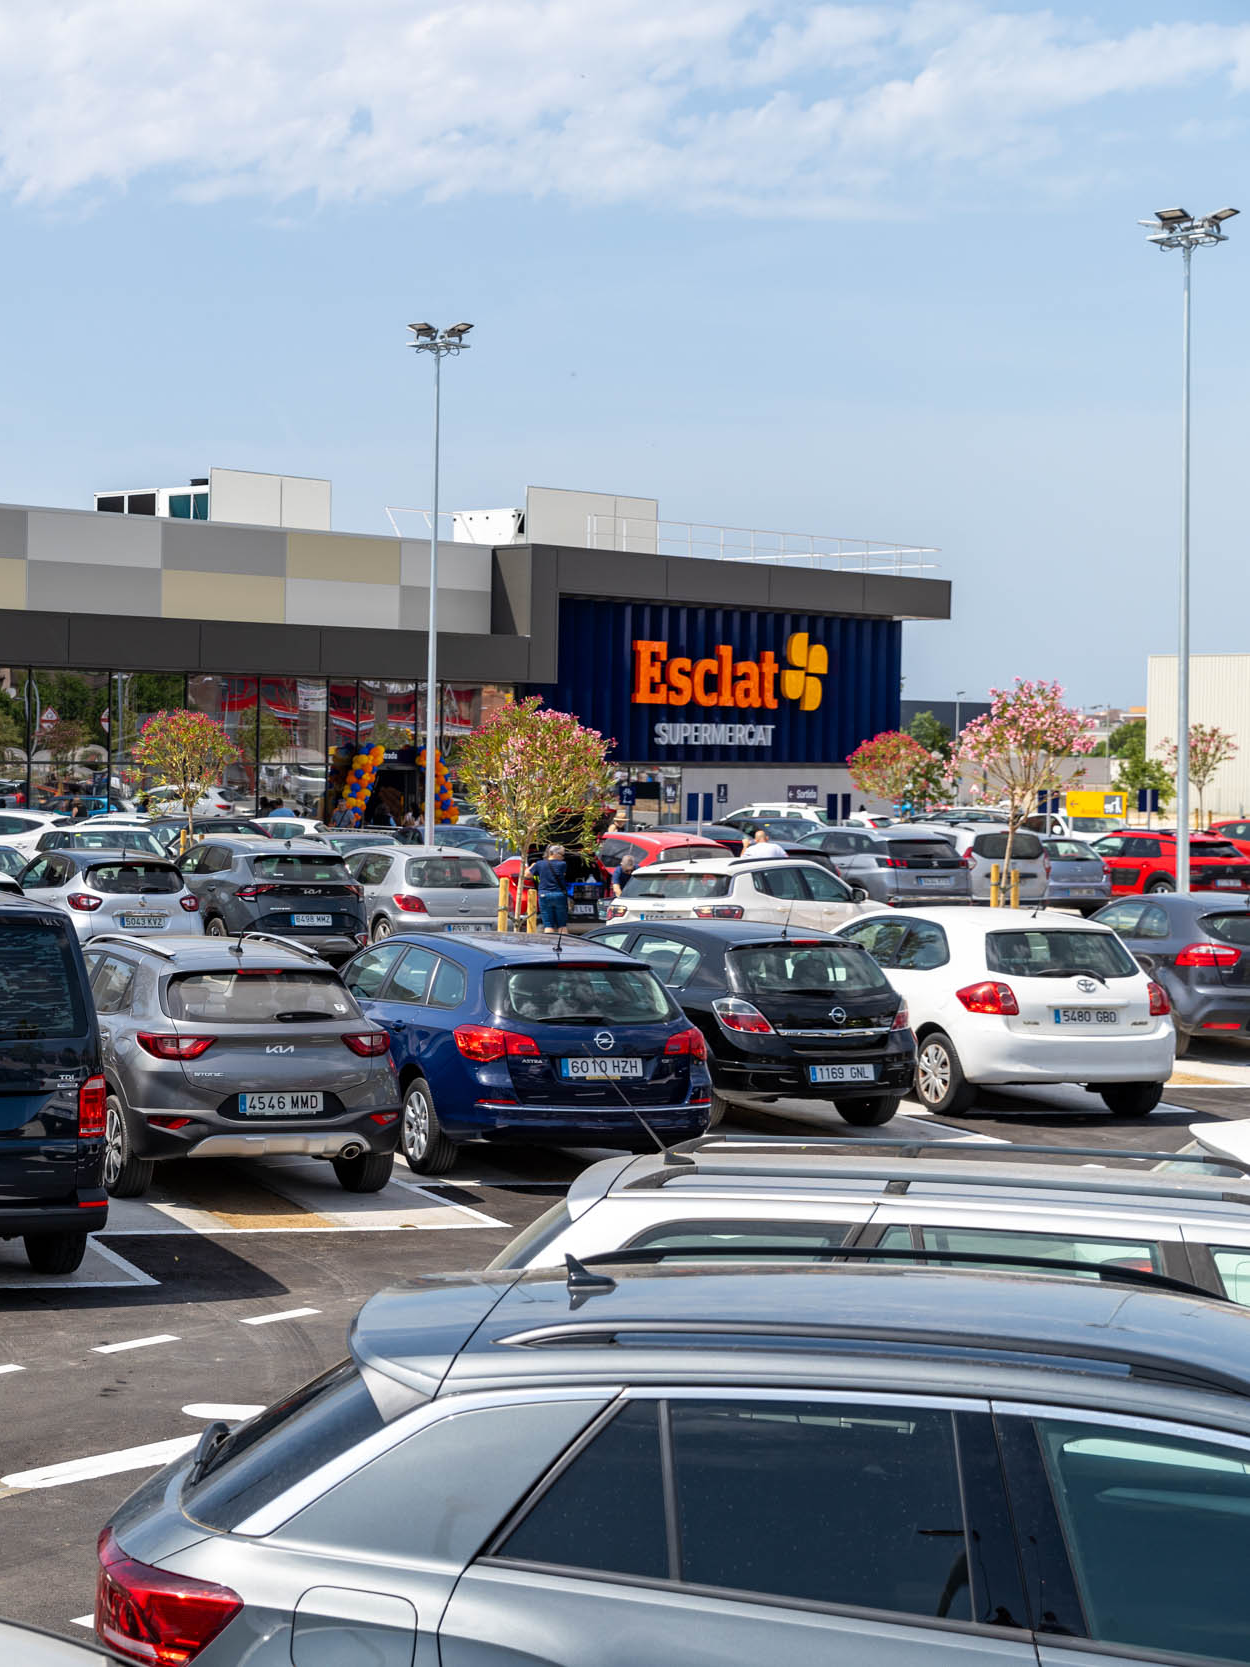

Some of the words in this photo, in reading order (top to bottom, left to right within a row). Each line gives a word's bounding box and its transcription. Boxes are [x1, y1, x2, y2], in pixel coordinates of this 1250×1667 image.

[631, 639, 778, 710] Esclat
[654, 723, 775, 746] SUPERMERCAT
[1063, 1010, 1091, 1022] 5480
[571, 1061, 607, 1074] 6010
[613, 1061, 638, 1073] HZH
[819, 1067, 845, 1080] 1169
[850, 1066, 869, 1079] GNL
[249, 1096, 286, 1110] 4546
[291, 1095, 318, 1109] MMD
